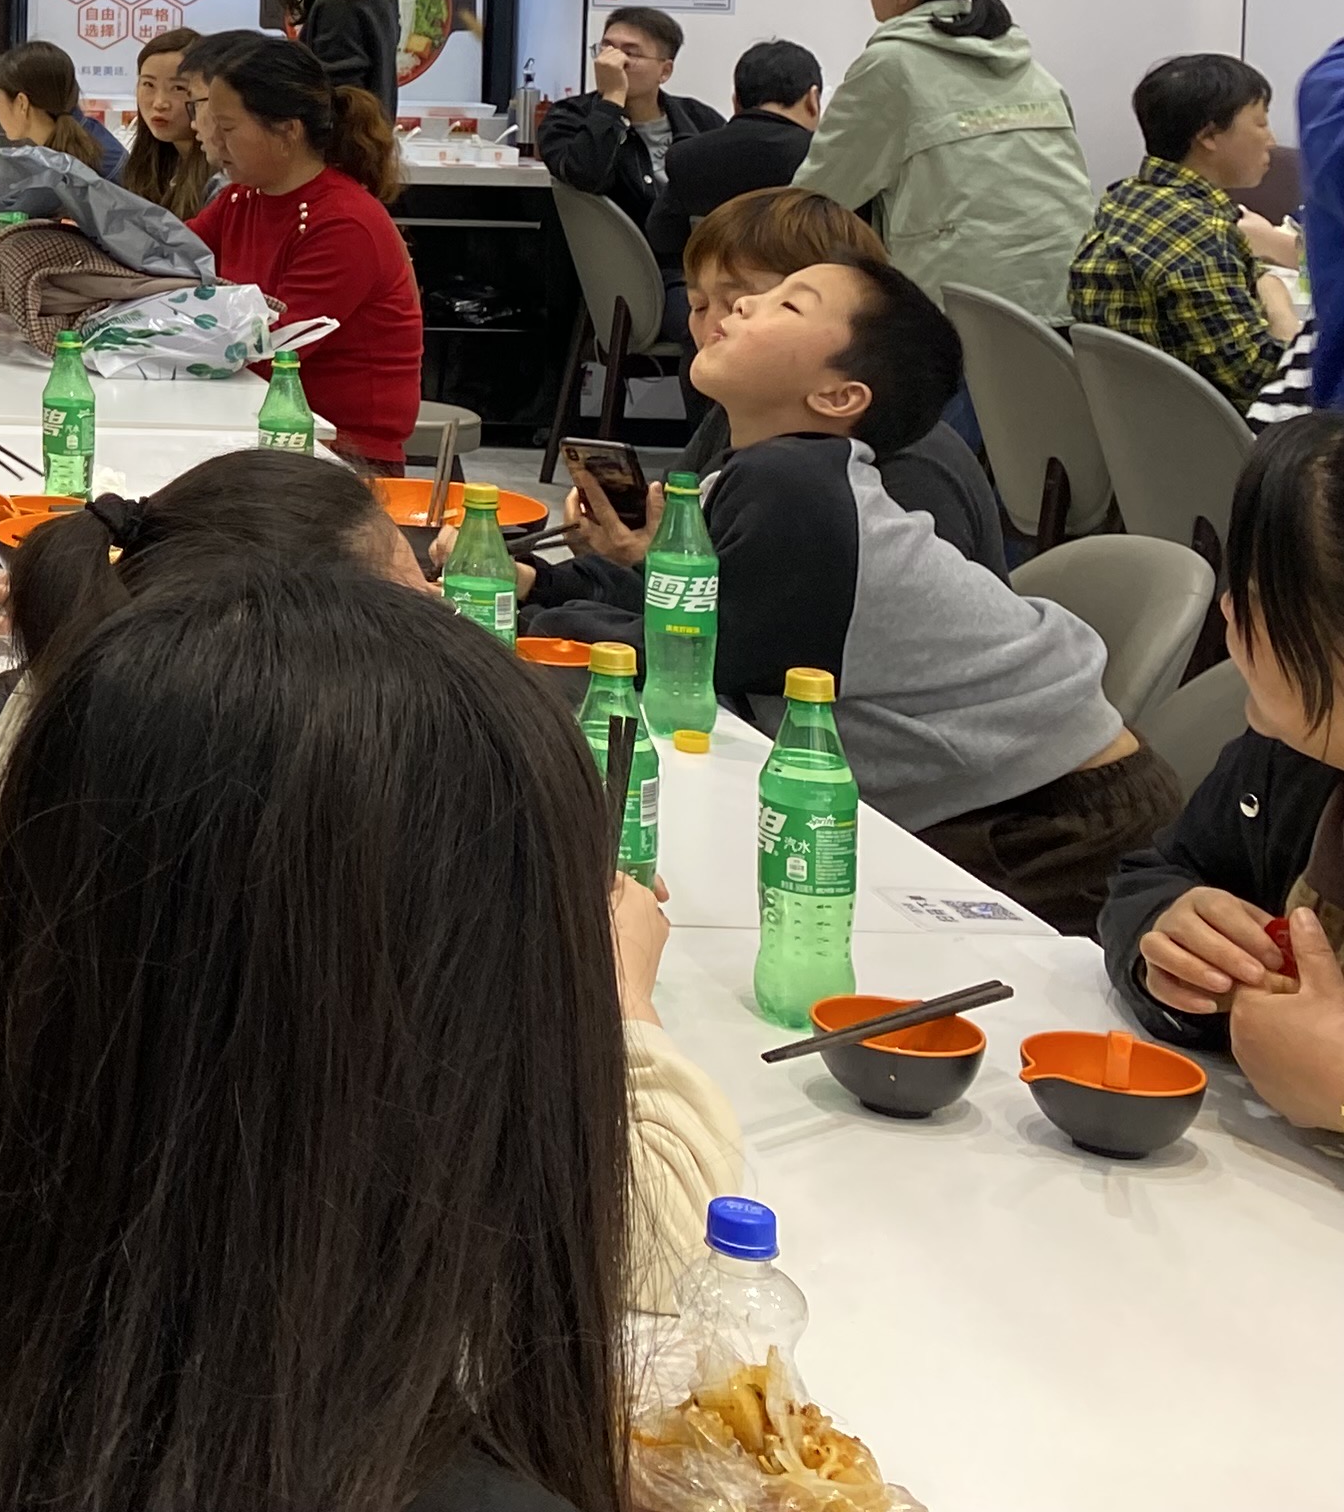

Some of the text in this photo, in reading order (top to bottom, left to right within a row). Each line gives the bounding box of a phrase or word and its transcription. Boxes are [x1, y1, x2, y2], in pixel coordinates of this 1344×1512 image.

[86, 7, 115, 21] 自由
[645, 570, 719, 613] 雪碧
[784, 836, 811, 854] 汽水
